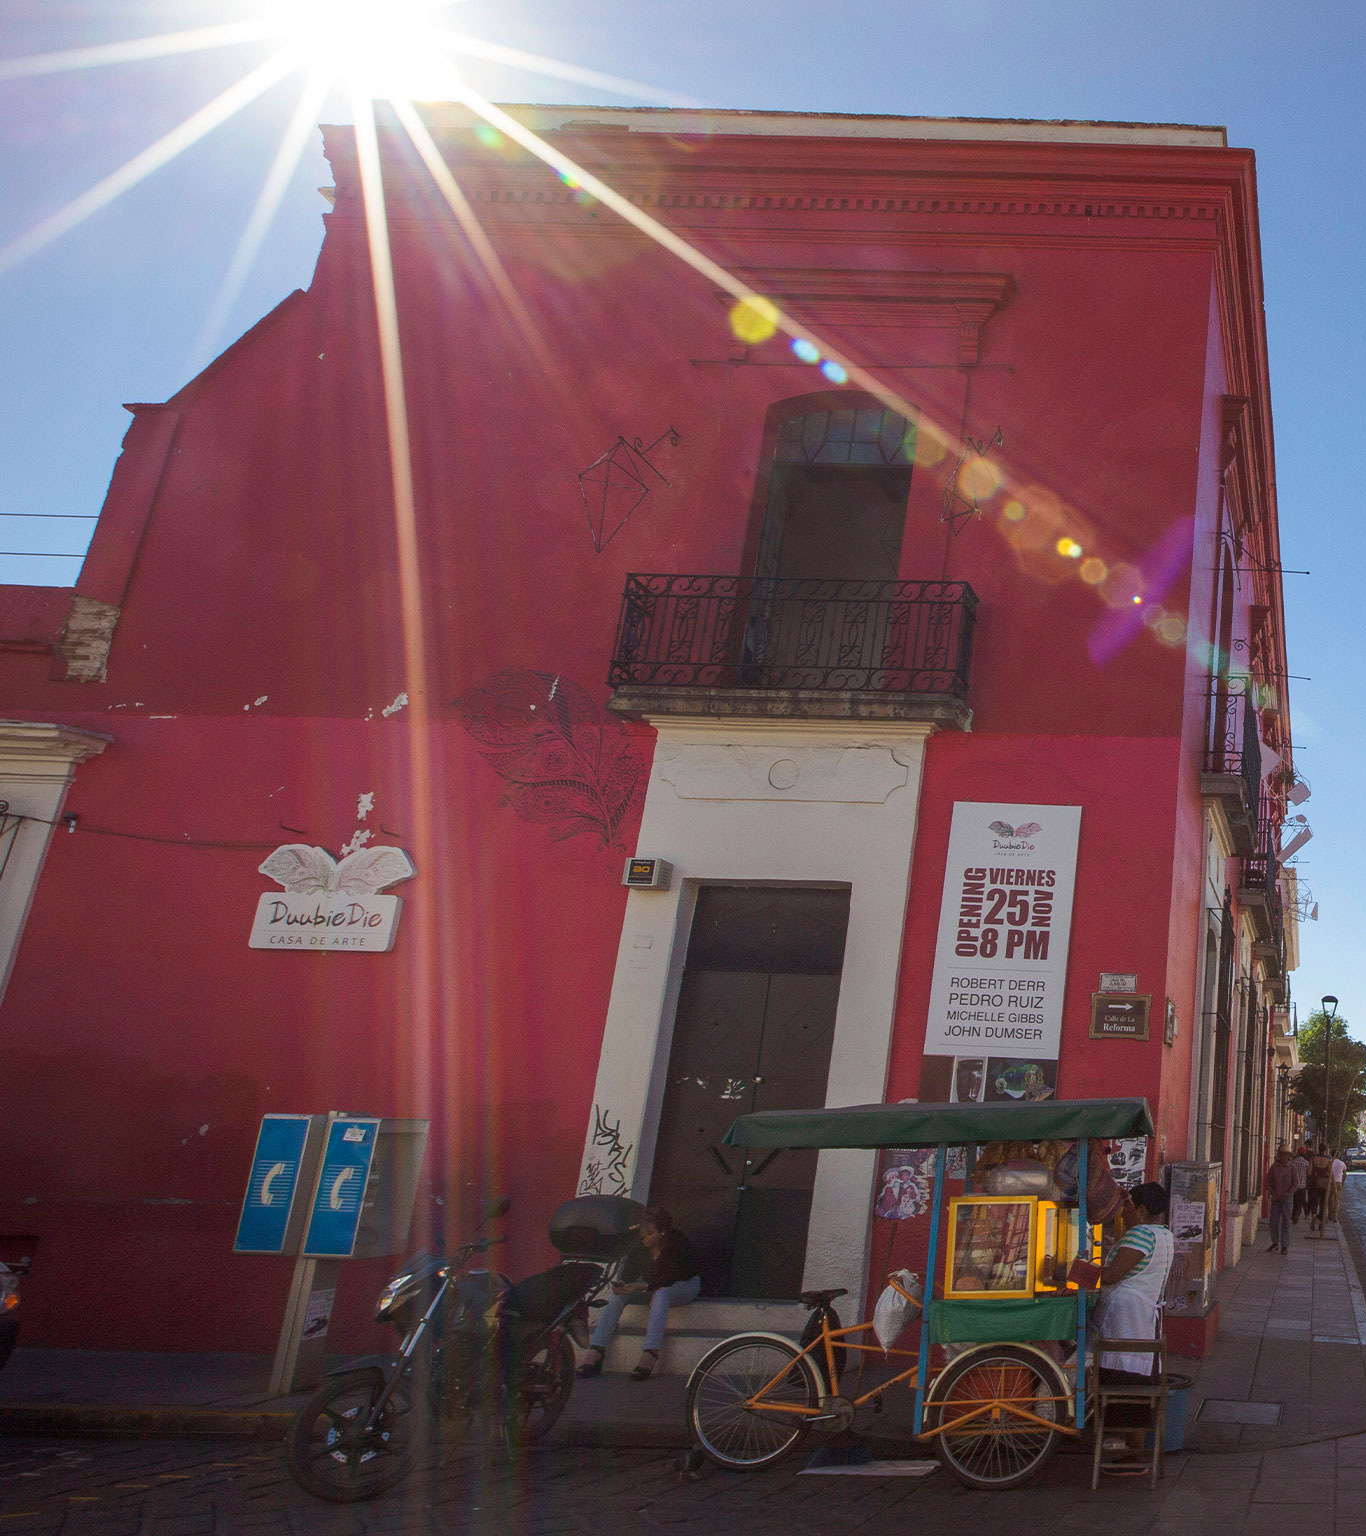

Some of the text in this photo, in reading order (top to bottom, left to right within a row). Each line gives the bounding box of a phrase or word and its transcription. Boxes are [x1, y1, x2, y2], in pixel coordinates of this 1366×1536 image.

[989, 867, 1056, 888] VIERNES
[269, 900, 383, 928] DuubieDie
[955, 867, 987, 958] OPENING
[983, 888, 1030, 927] 25
[1031, 889, 1054, 928] NOV
[270, 935, 366, 947] CASA DE ARTE
[979, 927, 1050, 960] 8 PM
[950, 977, 1046, 992] ROBERT DERR
[948, 993, 1044, 1009] PEDRO RUIZ
[946, 1010, 1044, 1024] MICHELLE GIBBS
[1104, 1015, 1119, 1023] Calle
[944, 1025, 1043, 1040] JOHN DUMSER
[1103, 1022, 1136, 1033] Reforma
